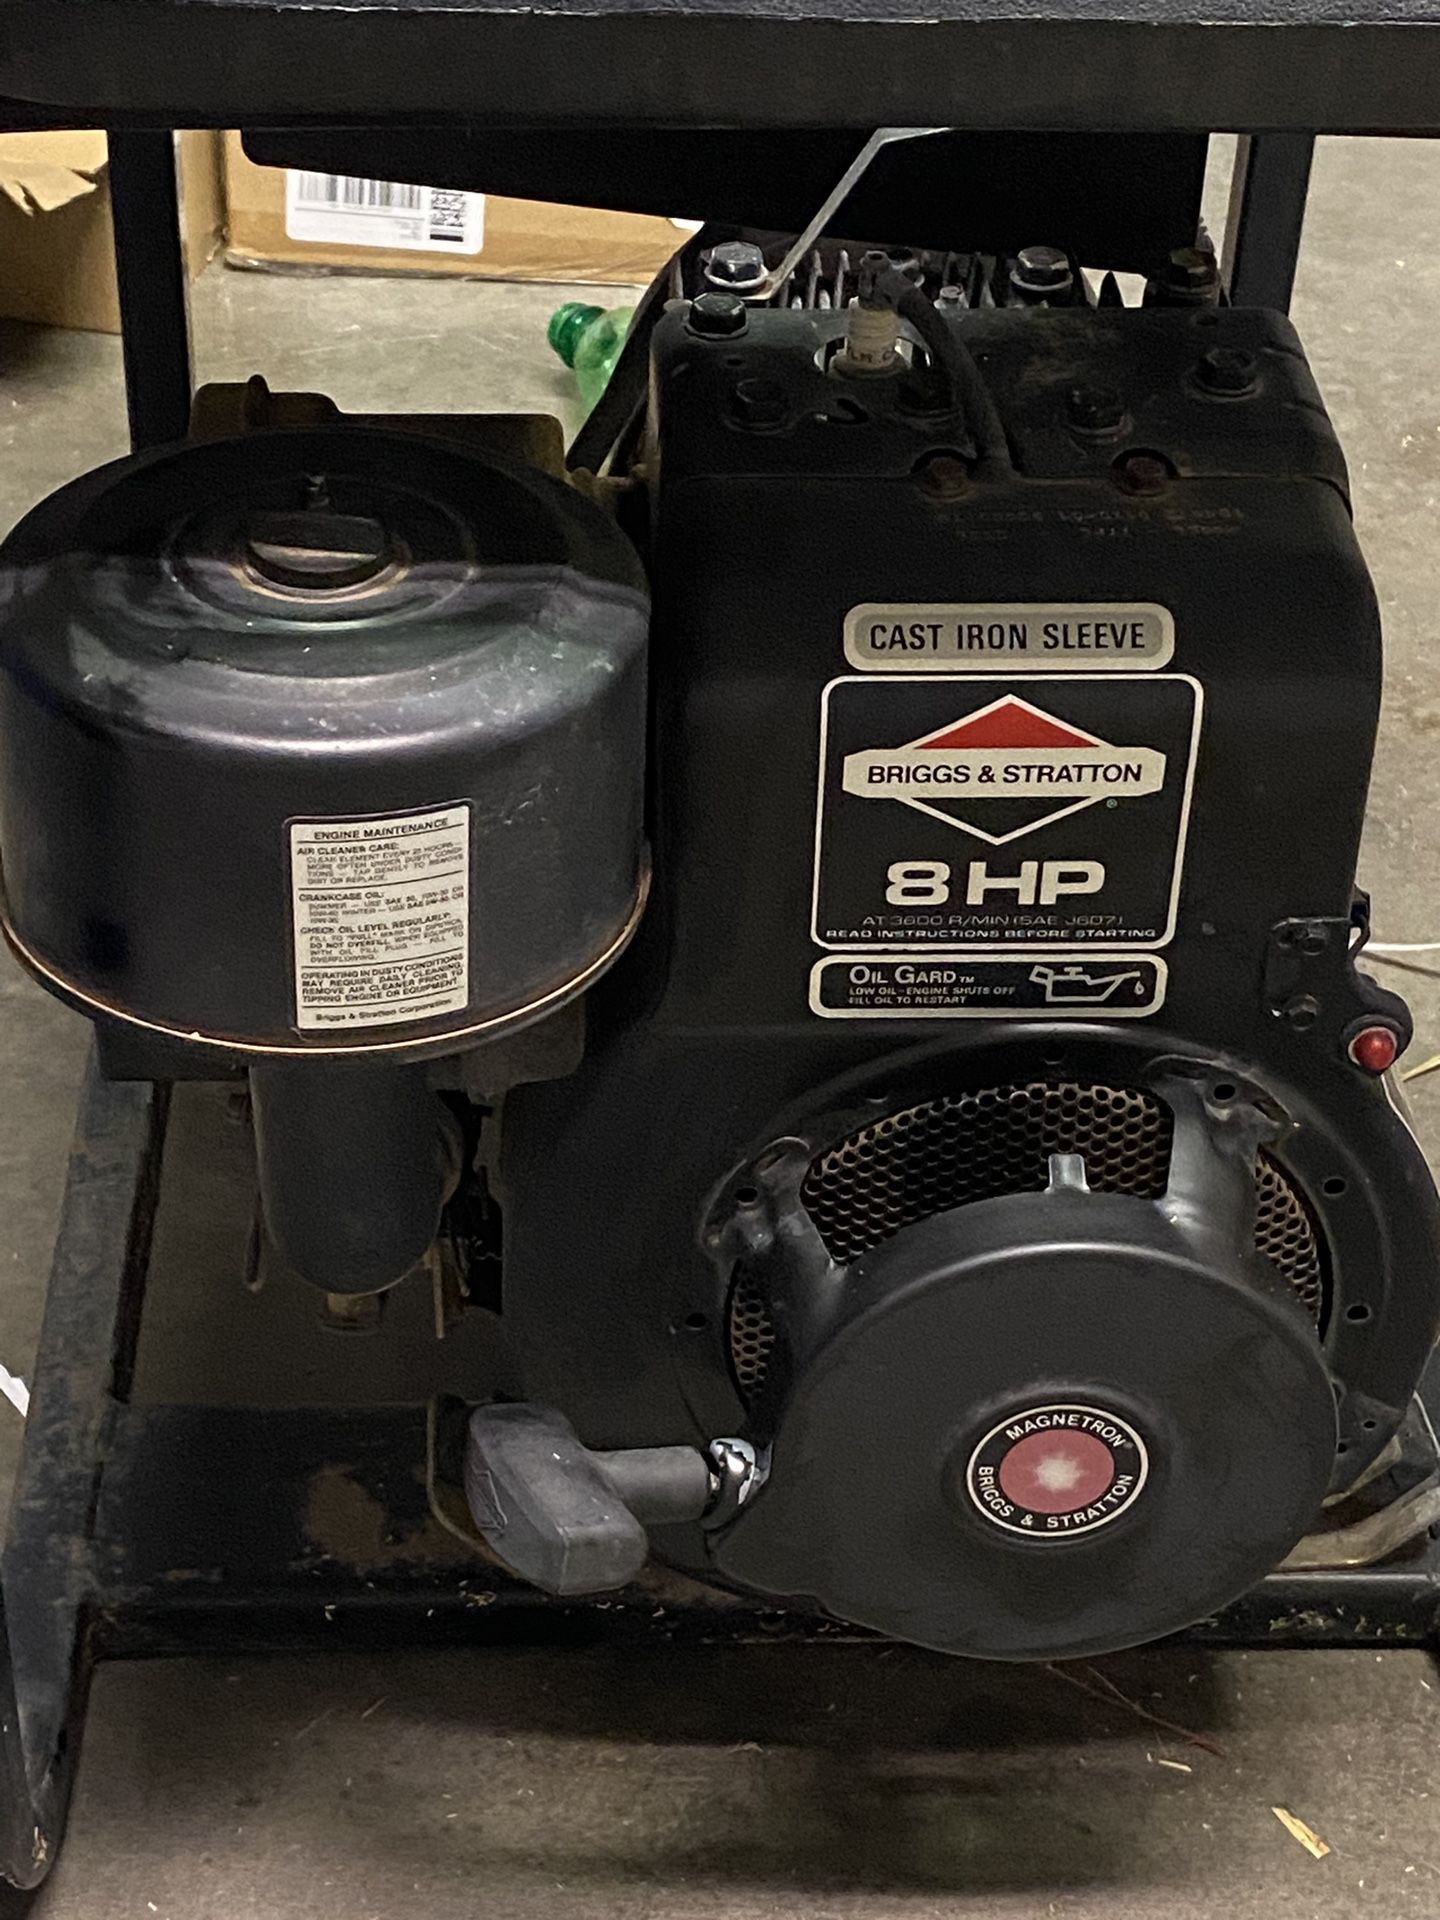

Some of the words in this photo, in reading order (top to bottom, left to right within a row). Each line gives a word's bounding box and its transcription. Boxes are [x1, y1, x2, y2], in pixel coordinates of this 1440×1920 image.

[870, 623, 943, 651] CAST
[958, 624, 1028, 650] IRON
[1042, 623, 1145, 650] SLEEVE
[867, 765, 970, 784] BRIGGS
[978, 765, 996, 783] &
[1002, 764, 1143, 783] STRATTON
[314, 830, 360, 840] ENGINE
[363, 818, 449, 838] MAINTENANCE
[297, 847, 315, 855] AIR
[317, 845, 366, 855] CLEANER
[368, 842, 400, 851] CARE:
[885, 860, 951, 906] 8
[966, 860, 1106, 906] HP
[298, 894, 362, 902] CRANKCASE
[365, 891, 384, 899] OIL:
[358, 924, 388, 932] LEVEL
[862, 915, 885, 926] AT
[890, 915, 942, 926] 3600
[948, 914, 1009, 926] R/MIN
[1013, 915, 1056, 927] (SAE
[826, 930, 872, 938] READ
[877, 929, 1000, 939] INSTRUCTIONS
[1004, 929, 1070, 938] BEFORE
[1075, 929, 1156, 938] STARTING
[301, 971, 358, 980] OPERATING
[372, 966, 403, 976] DUSTY
[404, 953, 464, 971] CONDITIONS
[849, 967, 889, 985] OIL
[894, 966, 956, 985] GARD
[330, 977, 373, 986] REQUIRE
[379, 973, 407, 983] DAILY
[345, 992, 383, 1001] ENGINE
[386, 990, 401, 998] OR
[403, 978, 458, 995] EQUIPMENT
[369, 979, 415, 992] CLEANER
[418, 972, 448, 984] PRIOR
[451, 968, 463, 977] TO
[849, 987, 876, 995] LOW
[952, 986, 990, 995] SHUTS
[993, 986, 1016, 995] OFF
[874, 996, 893, 1004] OIL
[896, 996, 912, 1004] TO
[915, 996, 967, 1004] RESTART
[316, 1013, 346, 1022] Briggs
[359, 1009, 397, 1019] Stratton
[400, 999, 452, 1015] Corporation
[1005, 1413, 1127, 1447] MAGNETRON
[978, 1466, 1015, 1517] BRIGGS
[1021, 1514, 1034, 1526] &
[1046, 1474, 1134, 1528] STRATTON
